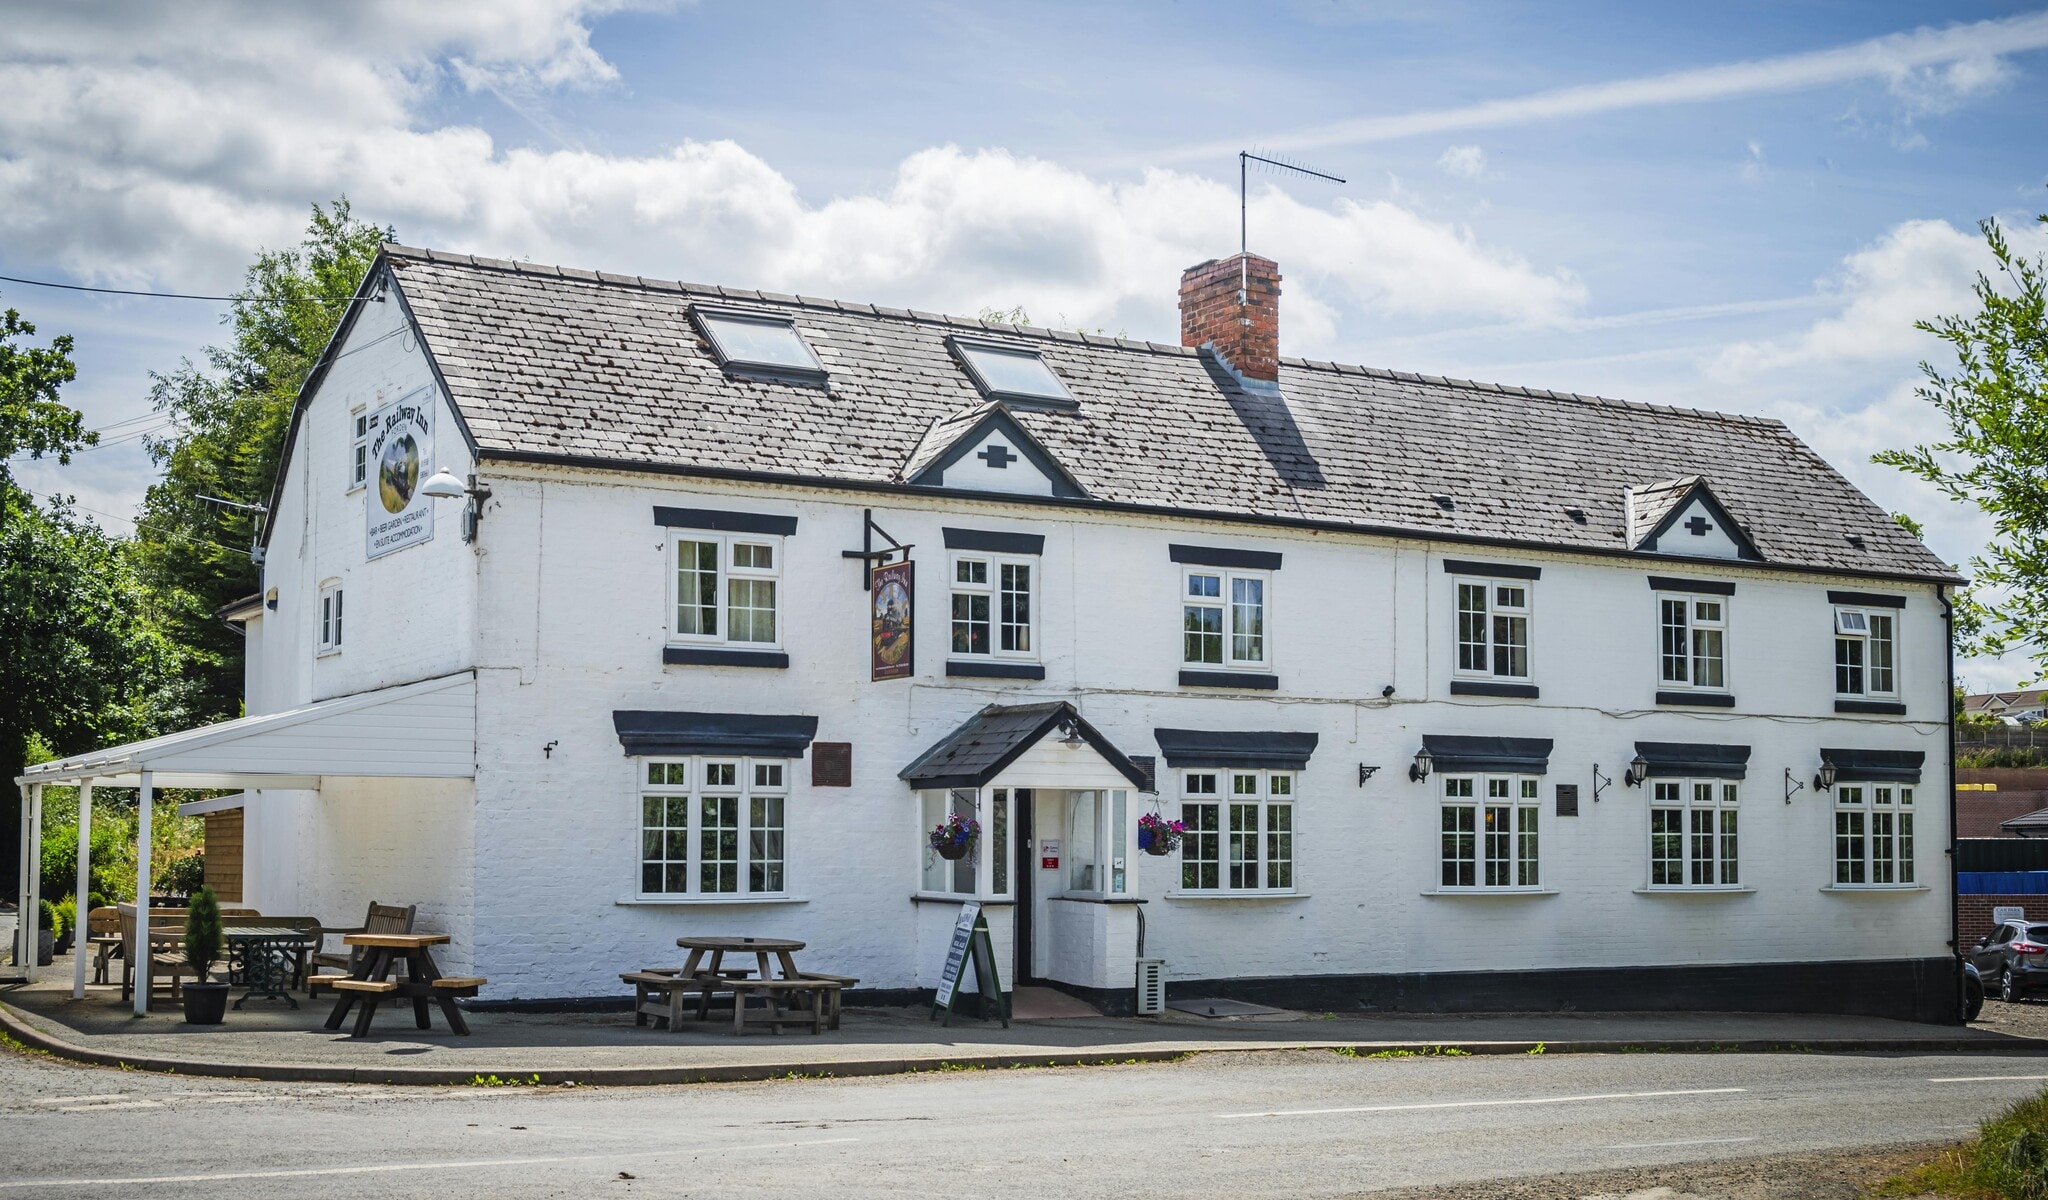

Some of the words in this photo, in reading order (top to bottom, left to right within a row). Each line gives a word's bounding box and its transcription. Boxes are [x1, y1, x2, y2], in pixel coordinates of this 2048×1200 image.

[372, 430, 386, 461] The
[386, 405, 415, 434] Railway
[415, 406, 428, 435] Inn
[391, 423, 407, 435] FORDEN
[388, 517, 402, 531] GARDEN
[390, 525, 421, 543] ACCOMMODATION
[875, 578, 883, 591] The
[883, 570, 901, 584] Railway
[901, 571, 909, 588] Inn
